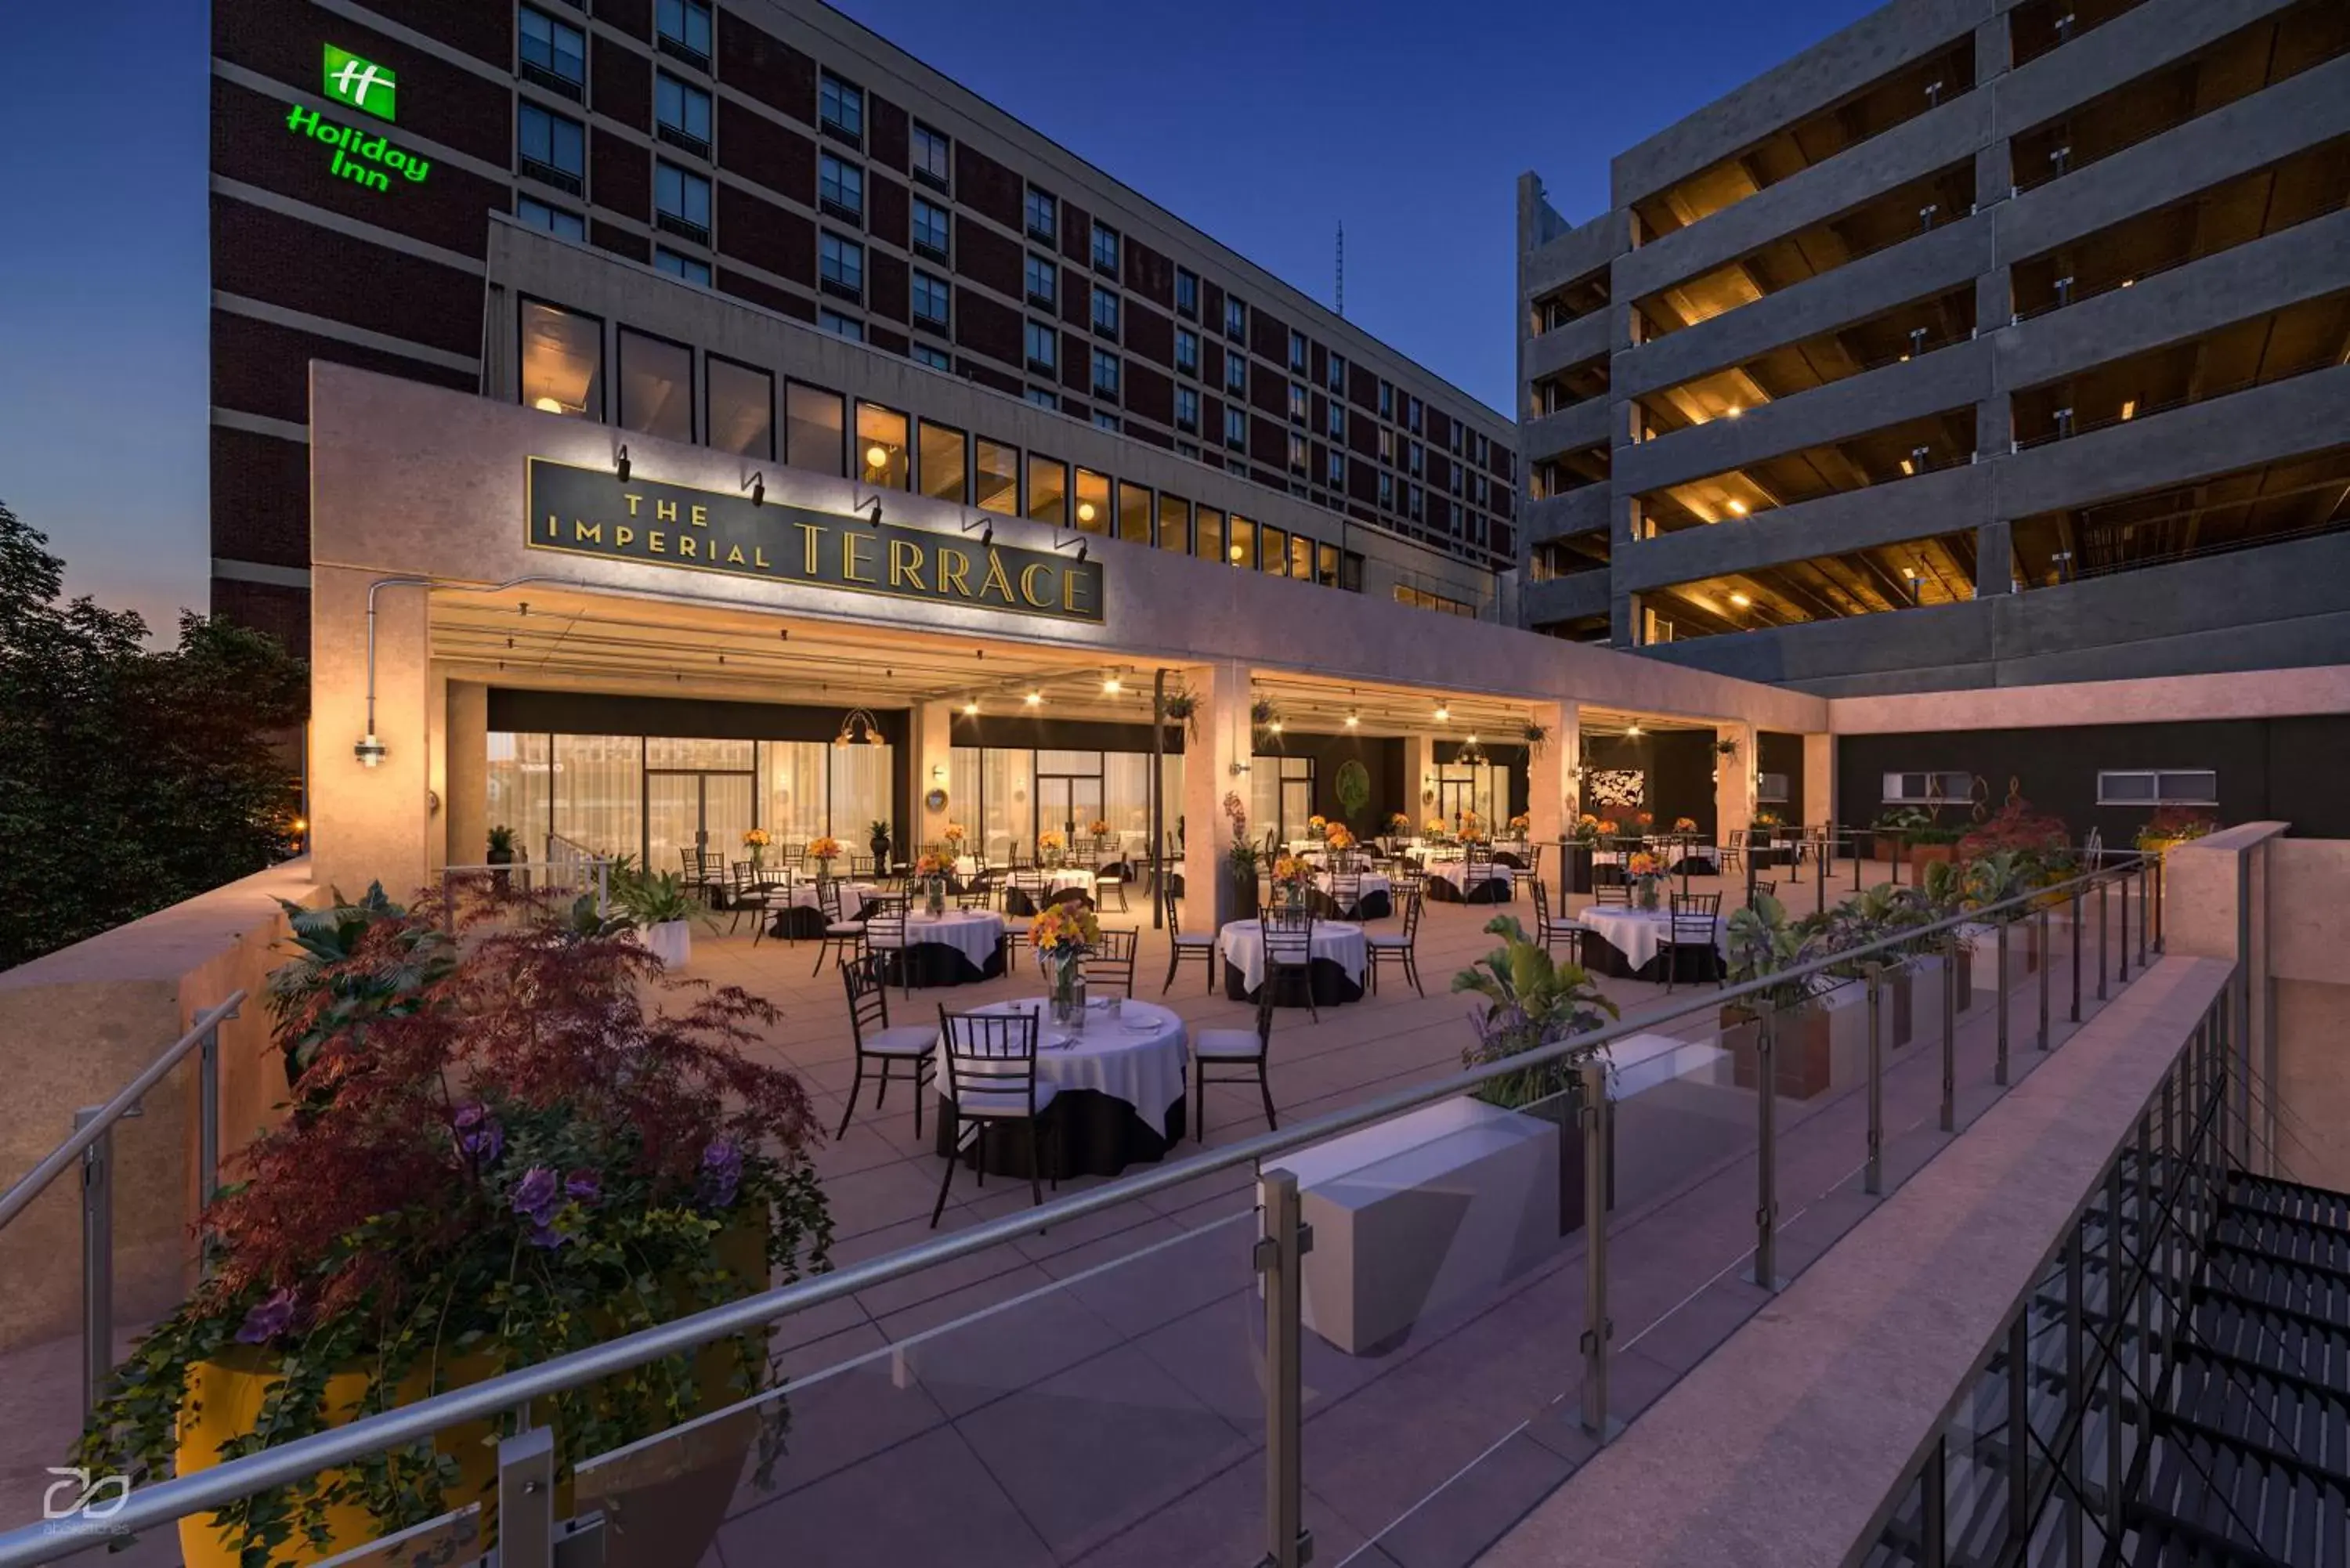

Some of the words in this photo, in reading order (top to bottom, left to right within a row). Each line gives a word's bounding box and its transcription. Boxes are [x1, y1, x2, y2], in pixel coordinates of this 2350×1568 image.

[287, 104, 430, 182] Holiday
[331, 150, 390, 191] Inn
[624, 493, 707, 527] THE
[548, 515, 772, 568] IMPERIAL
[793, 522, 1091, 613] TERRACE
